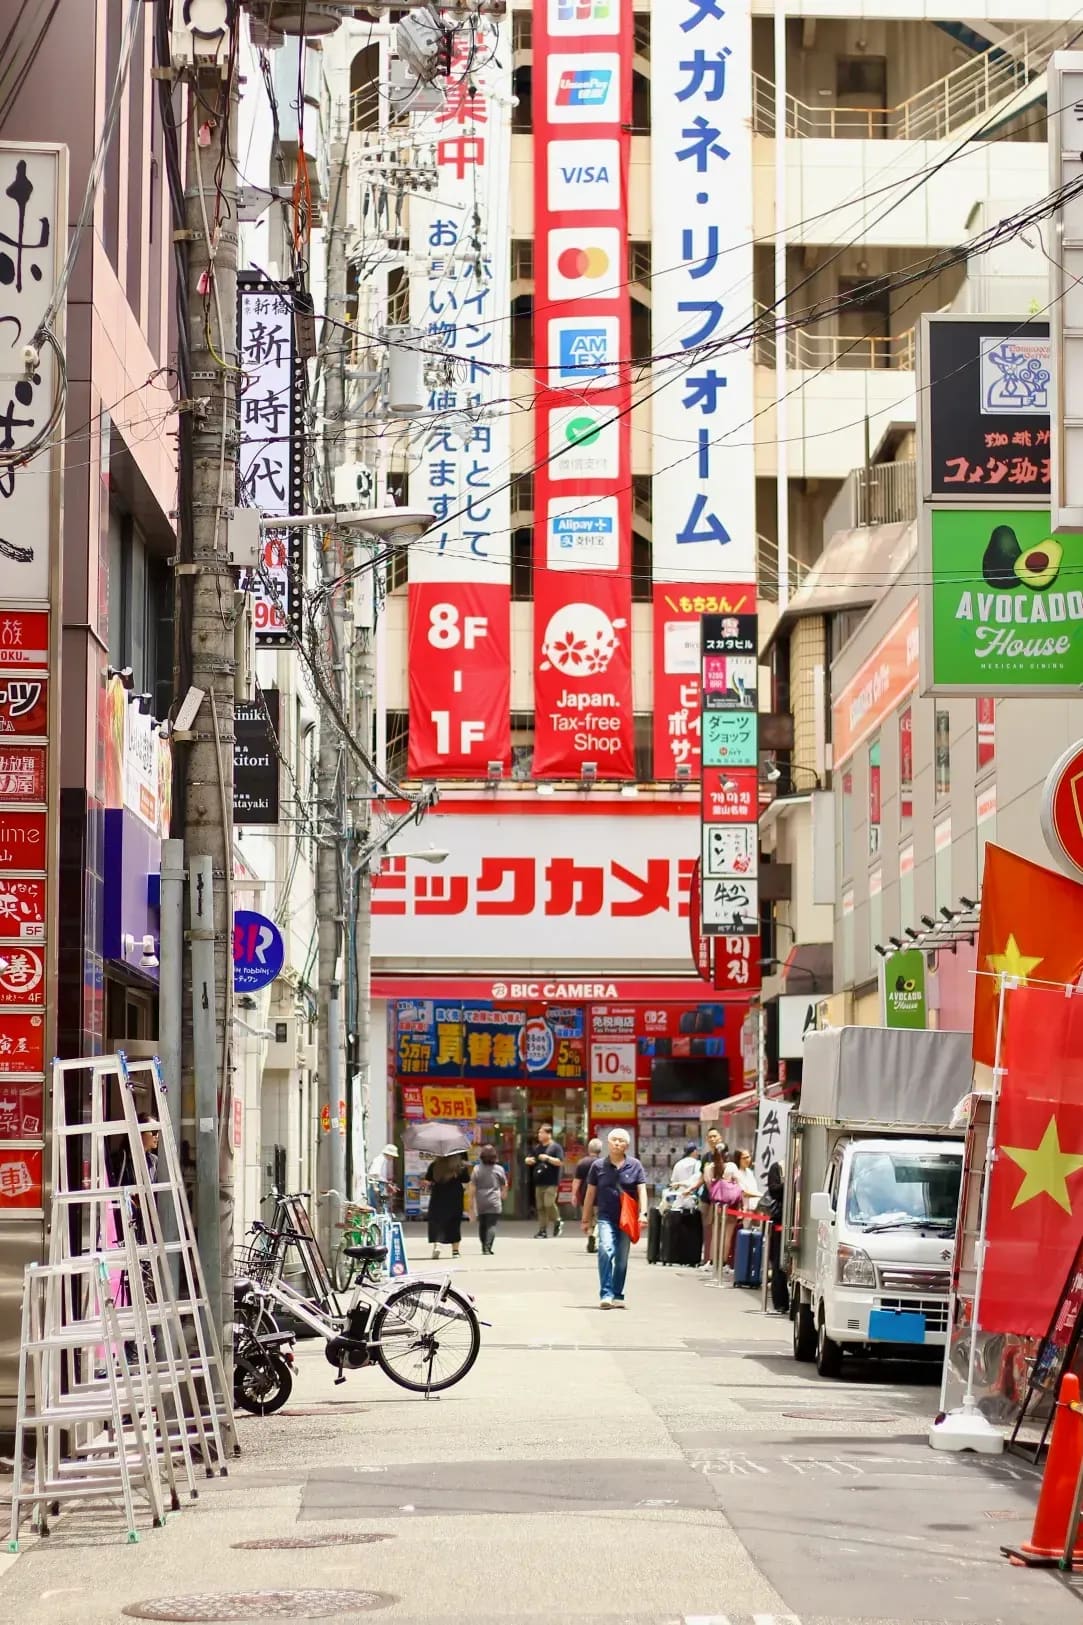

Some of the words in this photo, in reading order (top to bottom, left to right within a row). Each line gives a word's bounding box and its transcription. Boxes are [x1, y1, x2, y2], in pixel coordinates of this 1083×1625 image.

[560, 166, 609, 184] VISA
[674, 0, 732, 545] メガネ・リフォーム
[254, 297, 291, 316] 新橋
[570, 336, 607, 354] AM
[242, 321, 291, 502] 新時代
[679, 596, 733, 613] もちろん
[955, 591, 1083, 624] AVOCADO
[428, 603, 488, 650] 8F
[975, 626, 1070, 658] House
[0, 682, 41, 716] ツ
[556, 690, 620, 711] Japan.
[680, 681, 701, 708] ビ
[549, 713, 621, 730] Tax-free
[709, 715, 750, 729] ダーツ
[431, 710, 485, 755] 1F
[574, 734, 622, 754] Shop
[1, 820, 40, 843] ime
[713, 881, 750, 907] 牛かつ
[26, 926, 43, 936] 5F
[28, 992, 42, 1003] 4F
[511, 983, 540, 998] BIC
[543, 983, 618, 998] CAMERA
[888, 991, 923, 1001] AVOCADO
[595, 1052, 632, 1075] 10%
